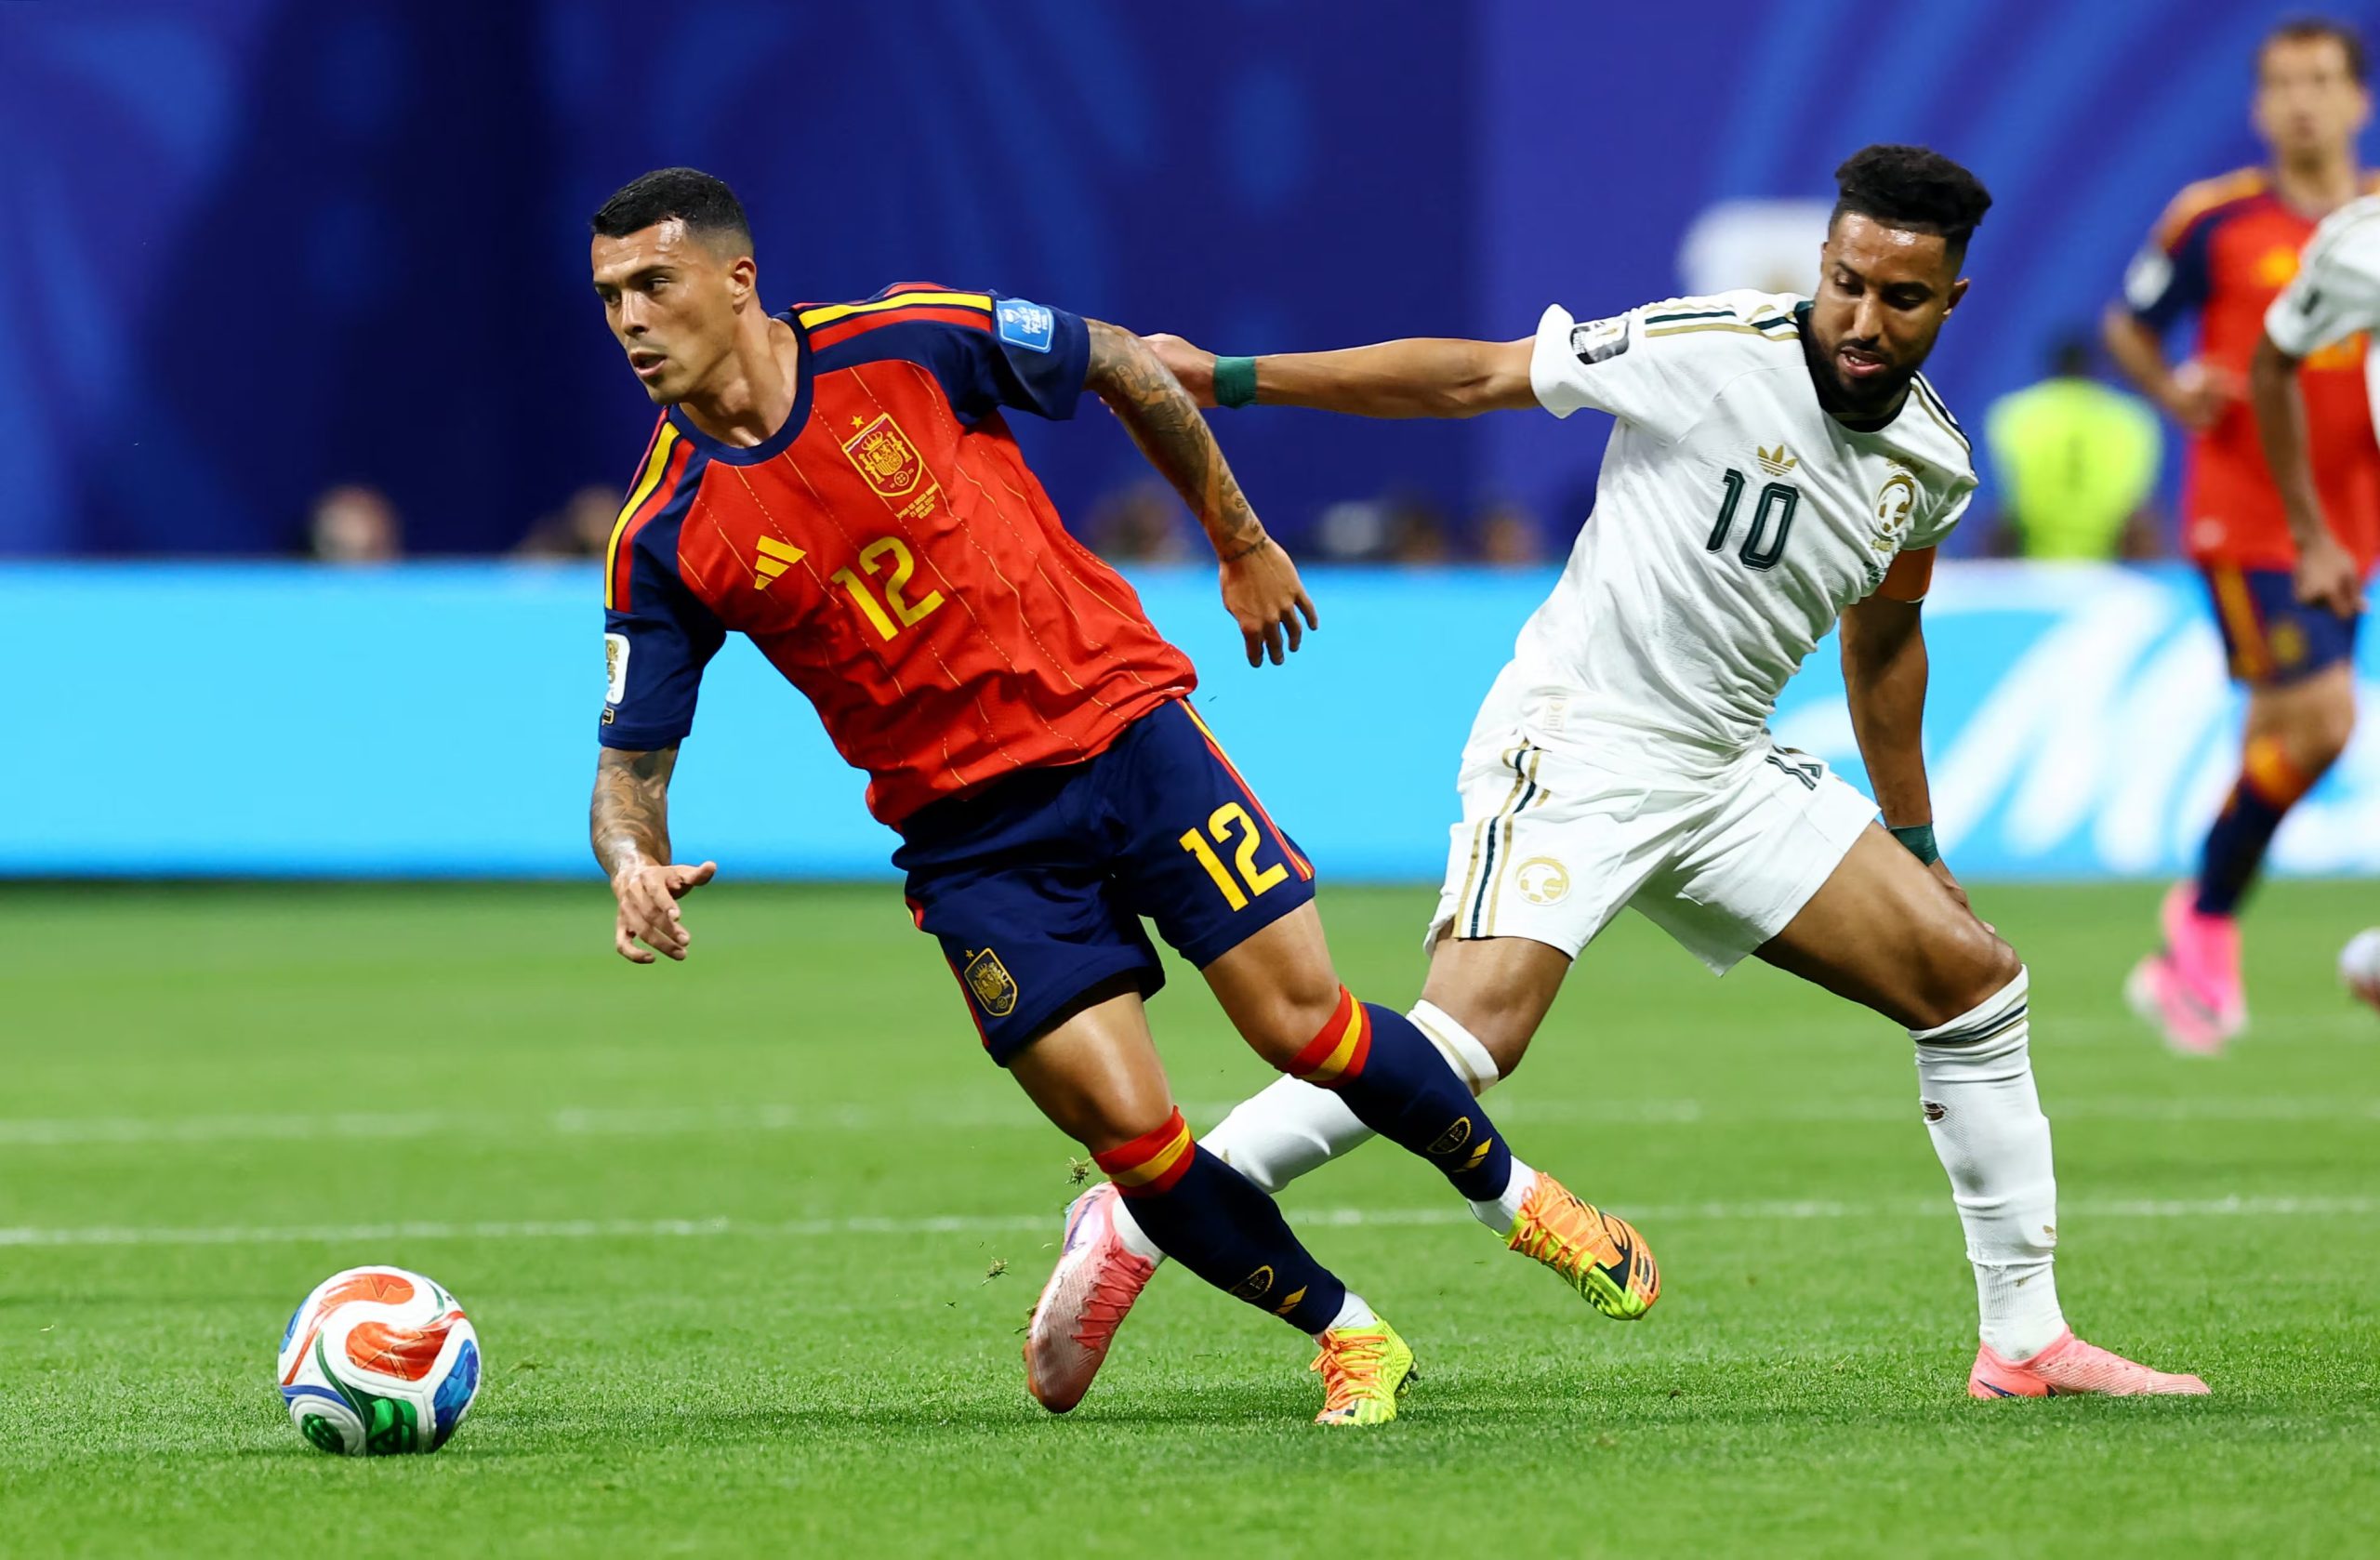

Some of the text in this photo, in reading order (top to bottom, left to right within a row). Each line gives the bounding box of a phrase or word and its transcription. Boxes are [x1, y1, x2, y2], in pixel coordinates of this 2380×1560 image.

[1706, 468, 1800, 572] 10
[830, 536, 945, 641] 12
[1179, 801, 1289, 912] 12
